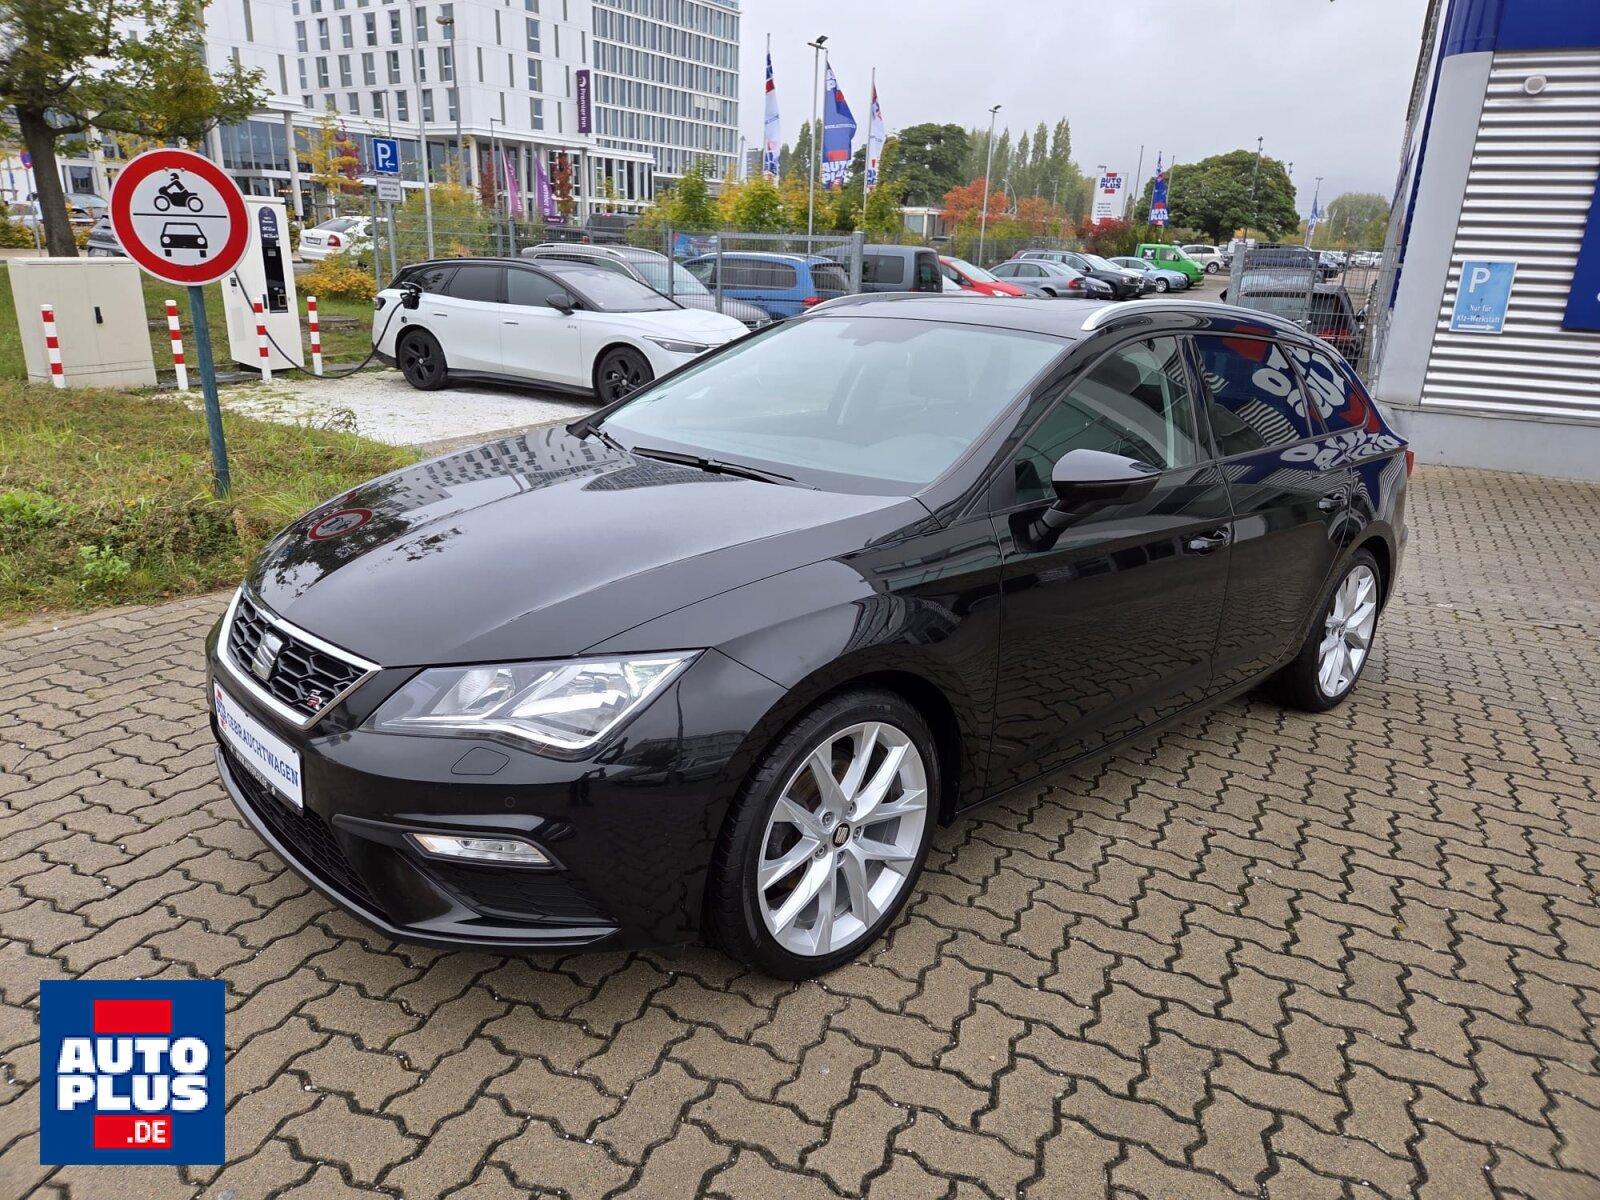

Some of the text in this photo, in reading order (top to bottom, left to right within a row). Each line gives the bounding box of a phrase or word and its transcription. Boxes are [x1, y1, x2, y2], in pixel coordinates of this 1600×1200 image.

[377, 143, 391, 168] P
[1469, 267, 1491, 293] P
[1456, 314, 1500, 323] Kfz-Werkstatt
[1470, 304, 1492, 312] Nur für
[226, 712, 299, 787] GEBRAUCHTWAGEN
